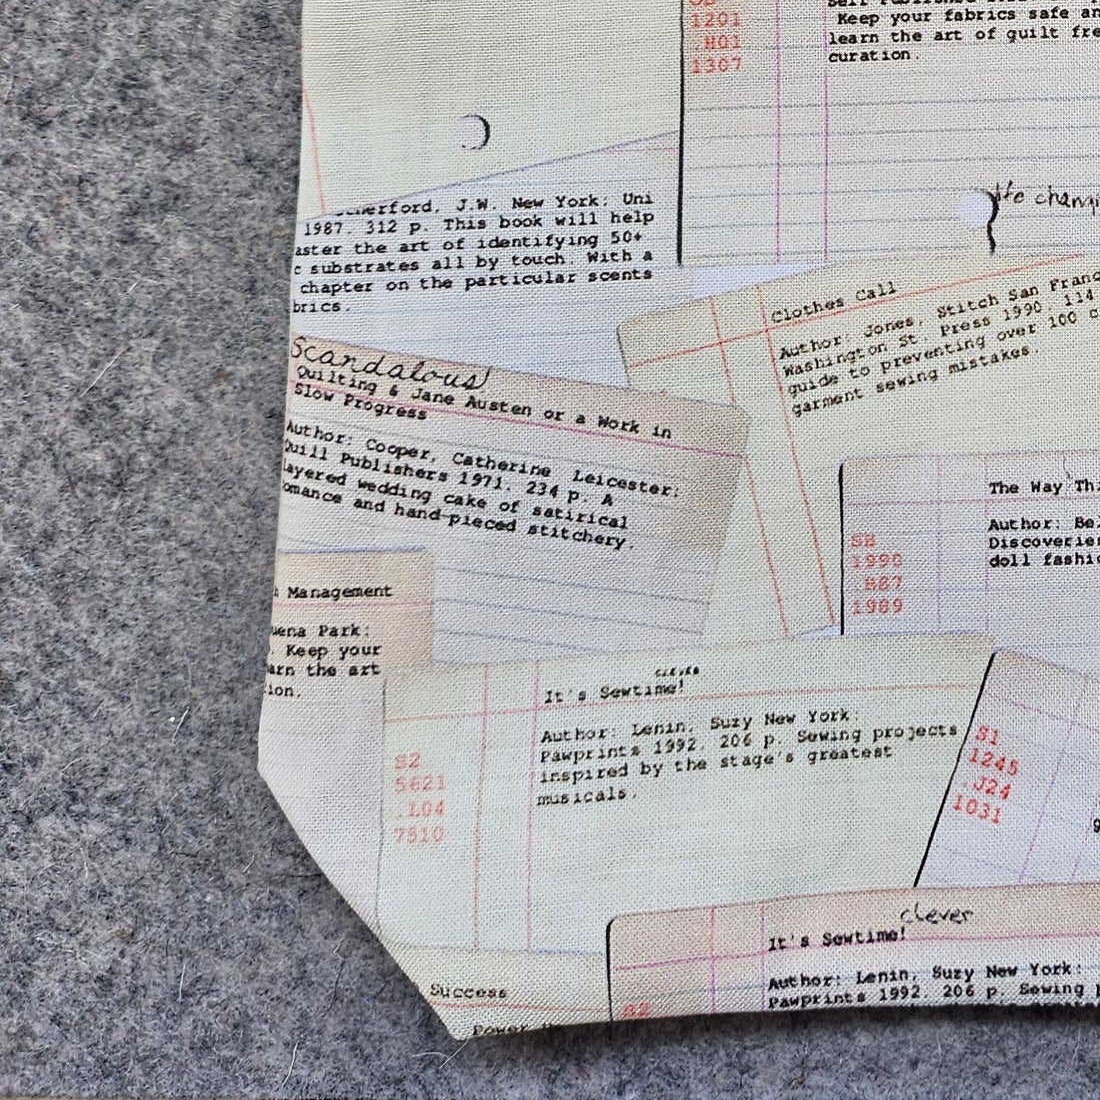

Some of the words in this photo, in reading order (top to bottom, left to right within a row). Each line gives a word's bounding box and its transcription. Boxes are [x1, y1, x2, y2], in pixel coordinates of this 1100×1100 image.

[837, 12, 880, 28] Keep
[890, 12, 932, 27] your
[944, 8, 1016, 22] fabrics
[1028, 5, 1069, 19] safe
[300, 280, 373, 297] chapter
[385, 280, 409, 291] on
[419, 276, 453, 290] the
[464, 270, 576, 292] particular
[588, 268, 653, 282] scents
[294, 382, 334, 402] Slow
[343, 393, 427, 421] Progress
[988, 480, 1019, 495] The
[1030, 480, 1063, 496] Way
[287, 585, 393, 602] Management
[544, 689, 586, 704] It's
[600, 678, 684, 700] Sewtime!
